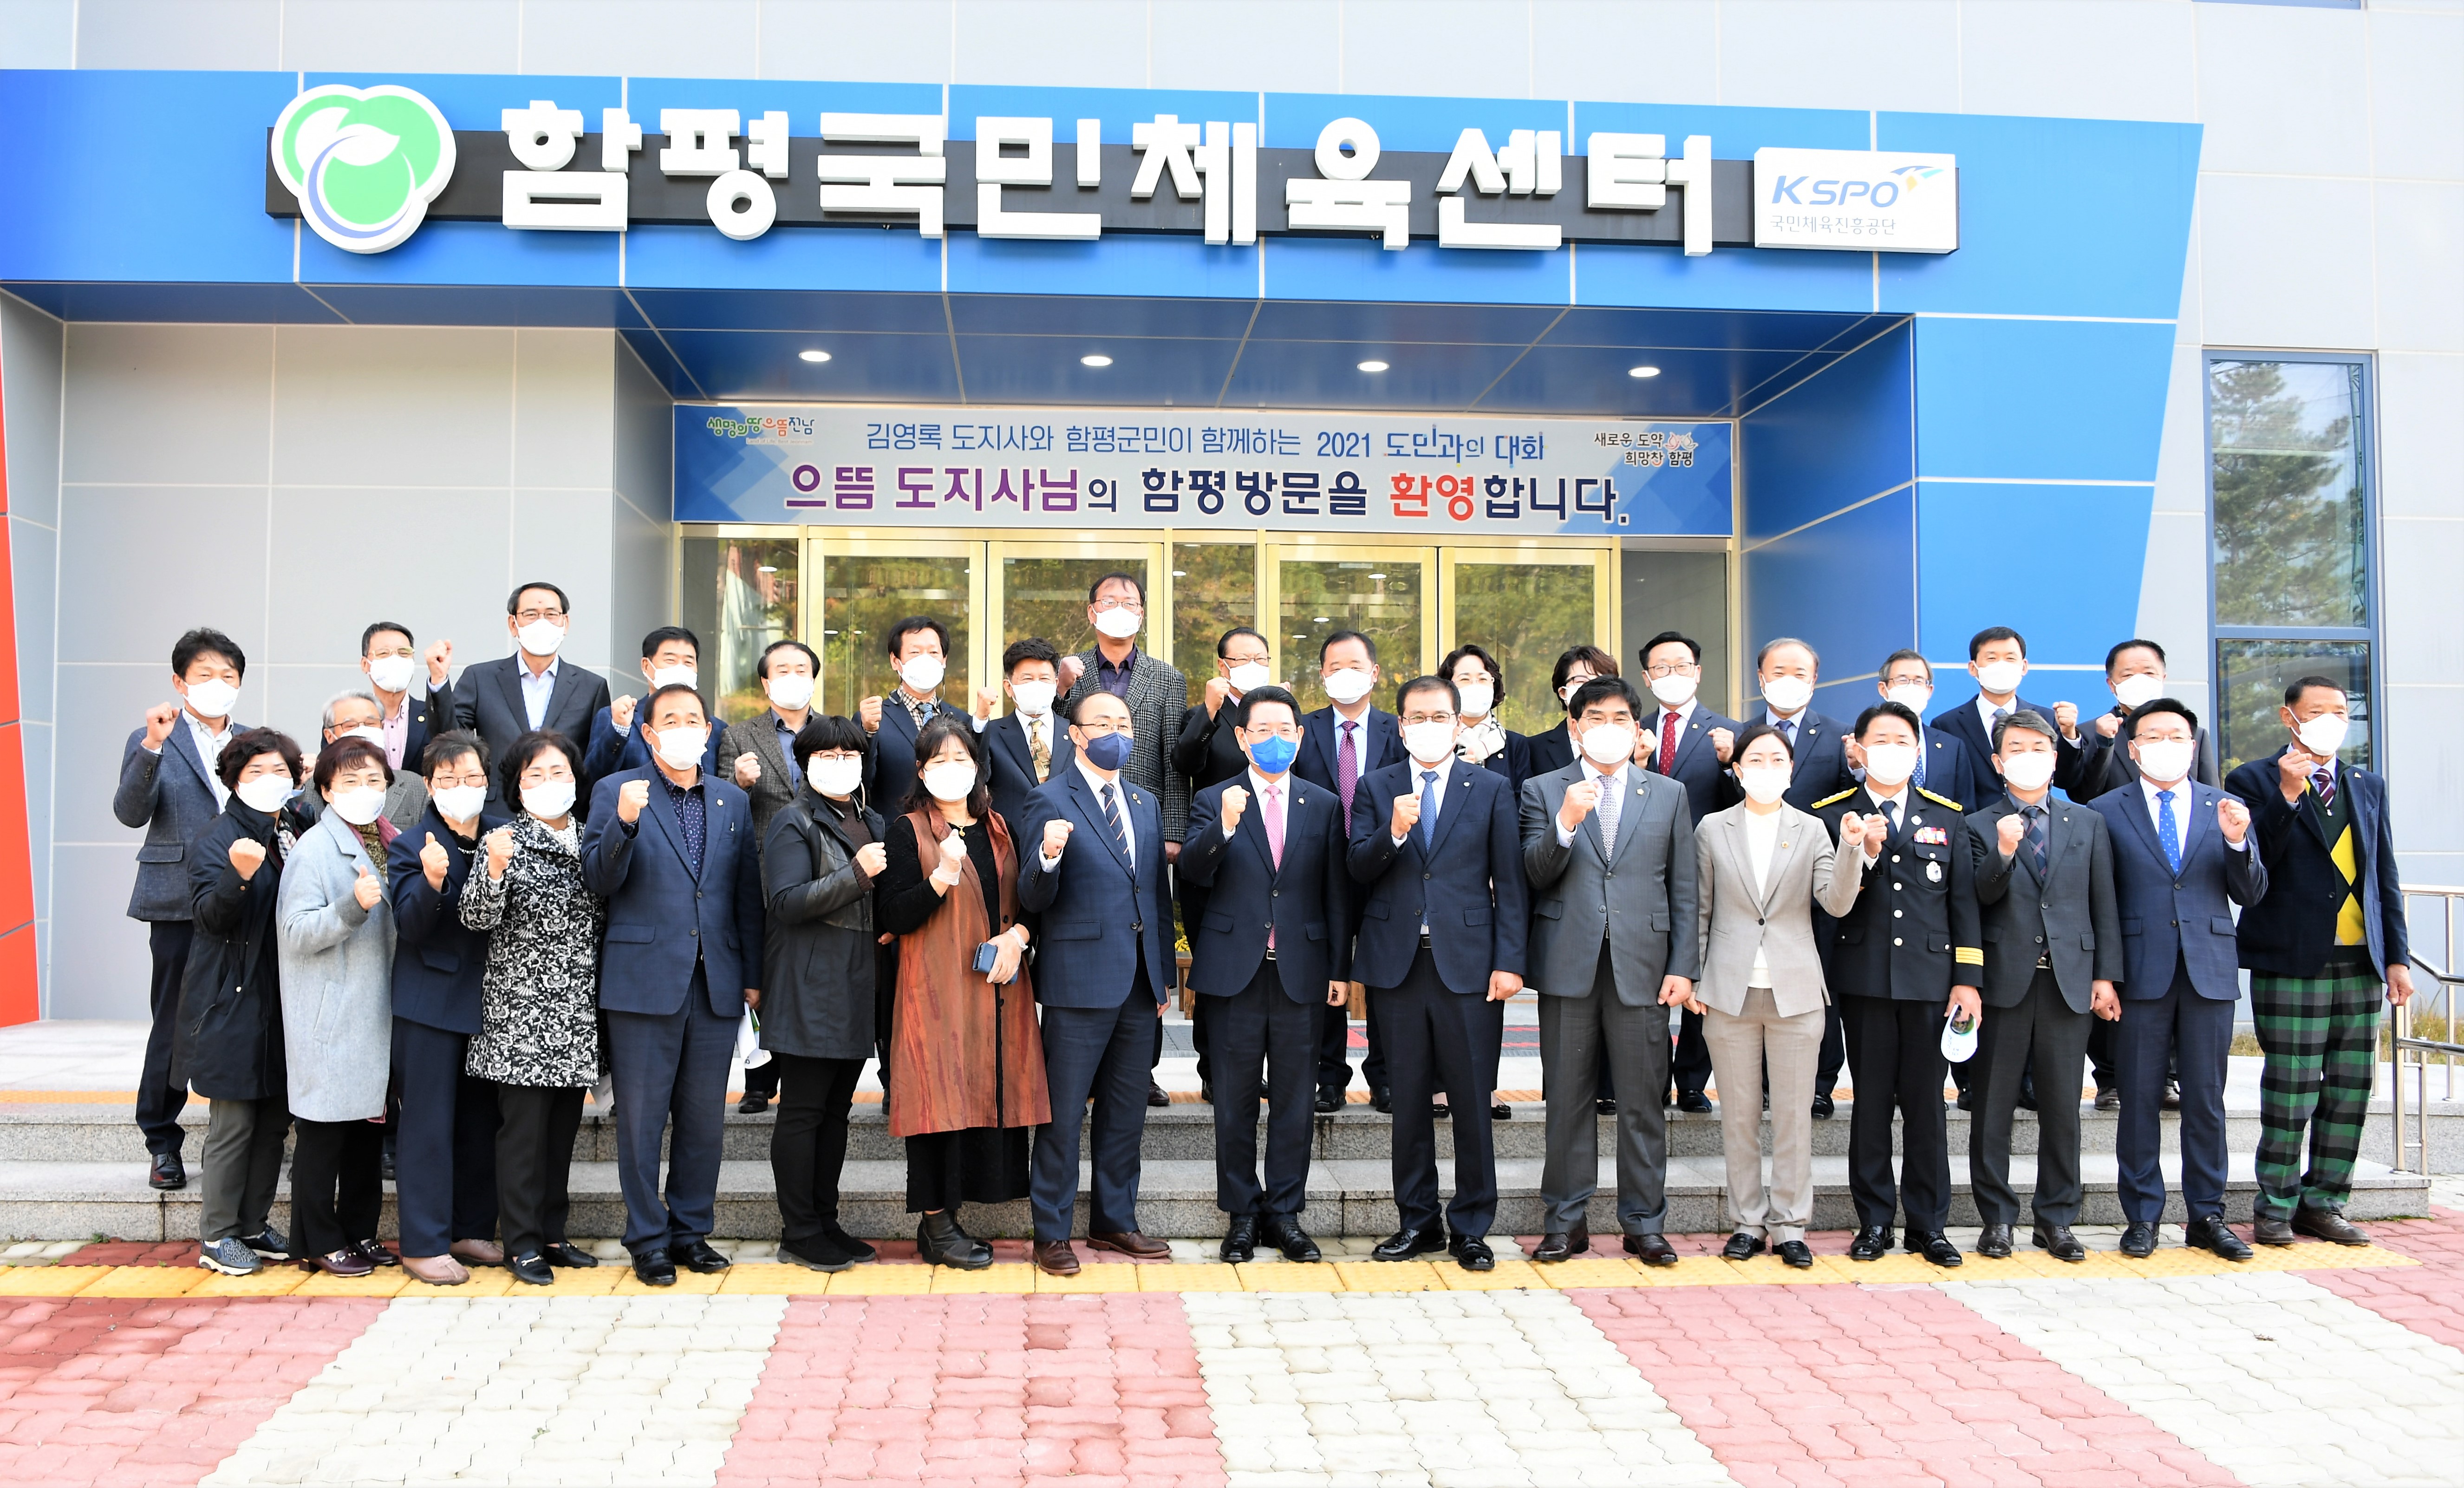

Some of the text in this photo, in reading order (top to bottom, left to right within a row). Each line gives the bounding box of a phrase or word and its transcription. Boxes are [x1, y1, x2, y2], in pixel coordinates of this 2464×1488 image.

[502, 100, 1712, 256] 함평국민체육센터
[1772, 175, 1899, 208] KSPO
[1770, 215, 1896, 235] 국민체육진흥공단
[867, 423, 1548, 468] 김영록 도지사와 함평군민이 함께하는 2021 도민과의 대화
[1594, 433, 1663, 448] 새로운 도약
[1625, 451, 1692, 466] 희망찬 함평
[786, 465, 1626, 523] 으뜸 도지사님의 함평방문을 환영합니다.
